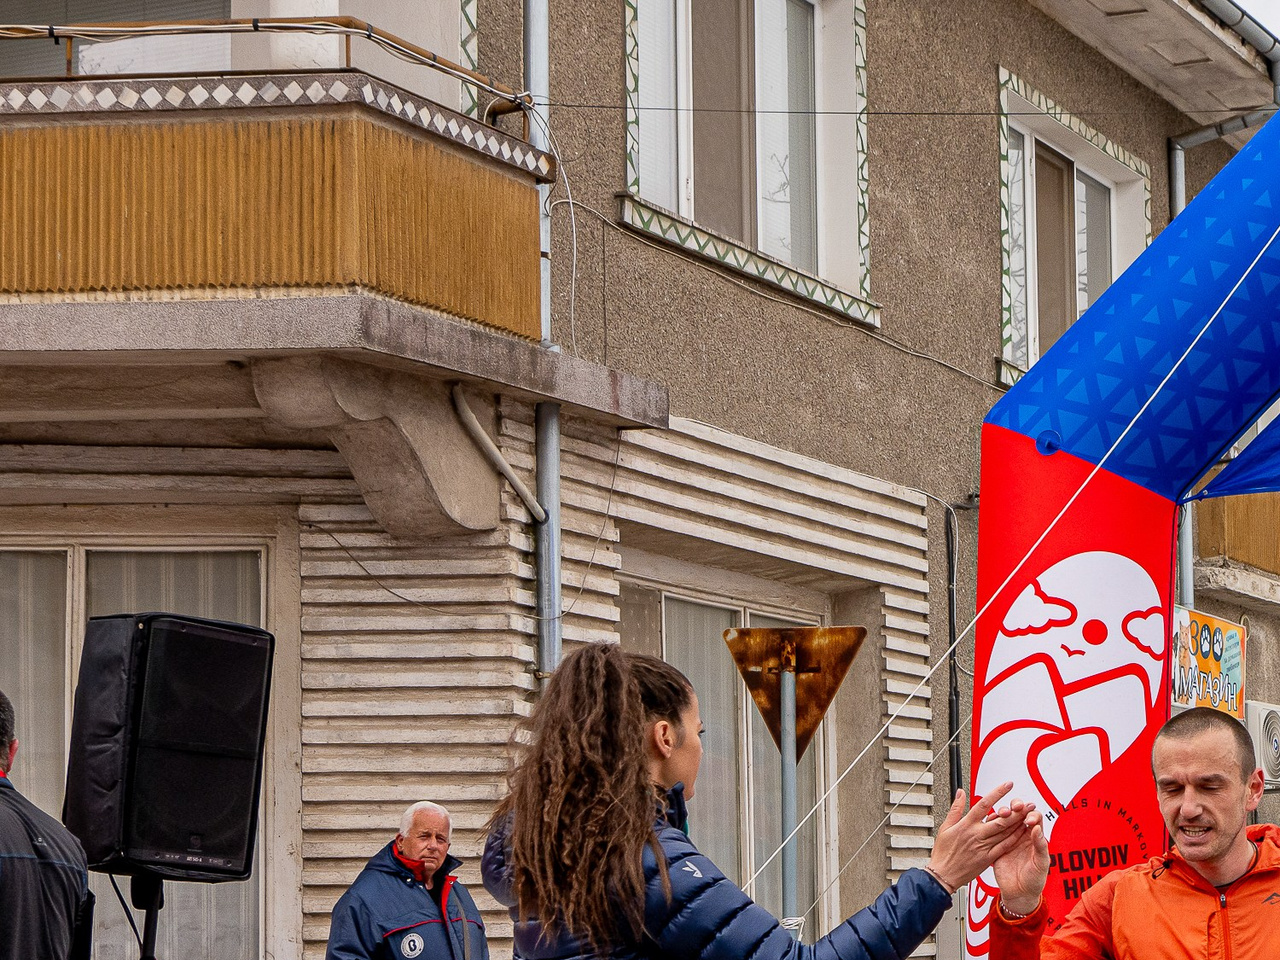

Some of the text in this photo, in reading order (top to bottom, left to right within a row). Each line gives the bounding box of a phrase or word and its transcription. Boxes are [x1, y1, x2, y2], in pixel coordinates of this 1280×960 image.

[1180, 664, 1238, 712] МАГАЗИН
[1117, 807, 1149, 860] MARKOV
[1048, 843, 1129, 876] PLOVDIV
